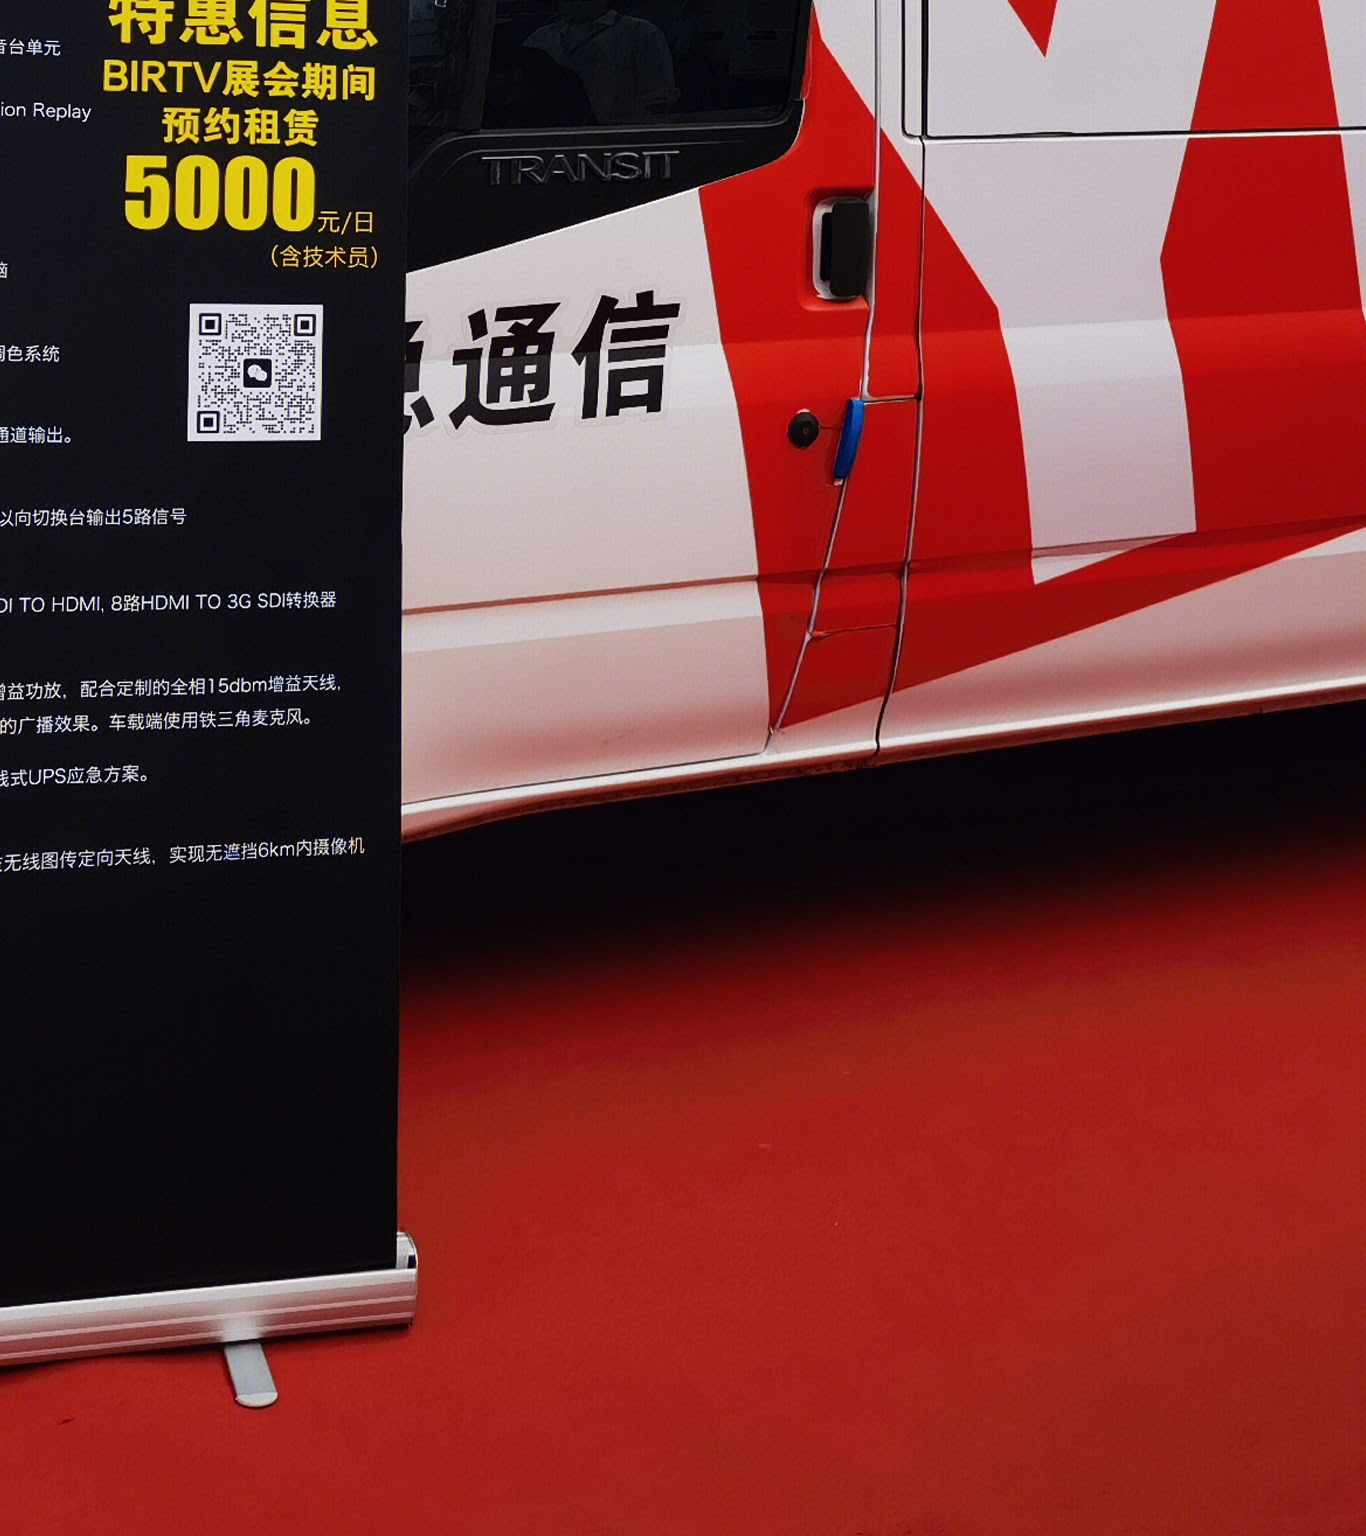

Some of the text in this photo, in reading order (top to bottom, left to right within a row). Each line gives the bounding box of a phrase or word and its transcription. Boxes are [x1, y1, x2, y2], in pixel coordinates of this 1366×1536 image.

[103, 60, 375, 101] BIRTV展会期间
[34, 103, 91, 122] Replay
[162, 107, 318, 146] 预约租赁
[482, 151, 680, 186] TRANSIT
[125, 155, 372, 235] 5000 元/日
[19, 597, 45, 612] TO
[111, 595, 189, 611] 8路HDMI
[196, 594, 220, 609] TO
[228, 594, 251, 608] 3G
[258, 592, 336, 608] SDI转换器
